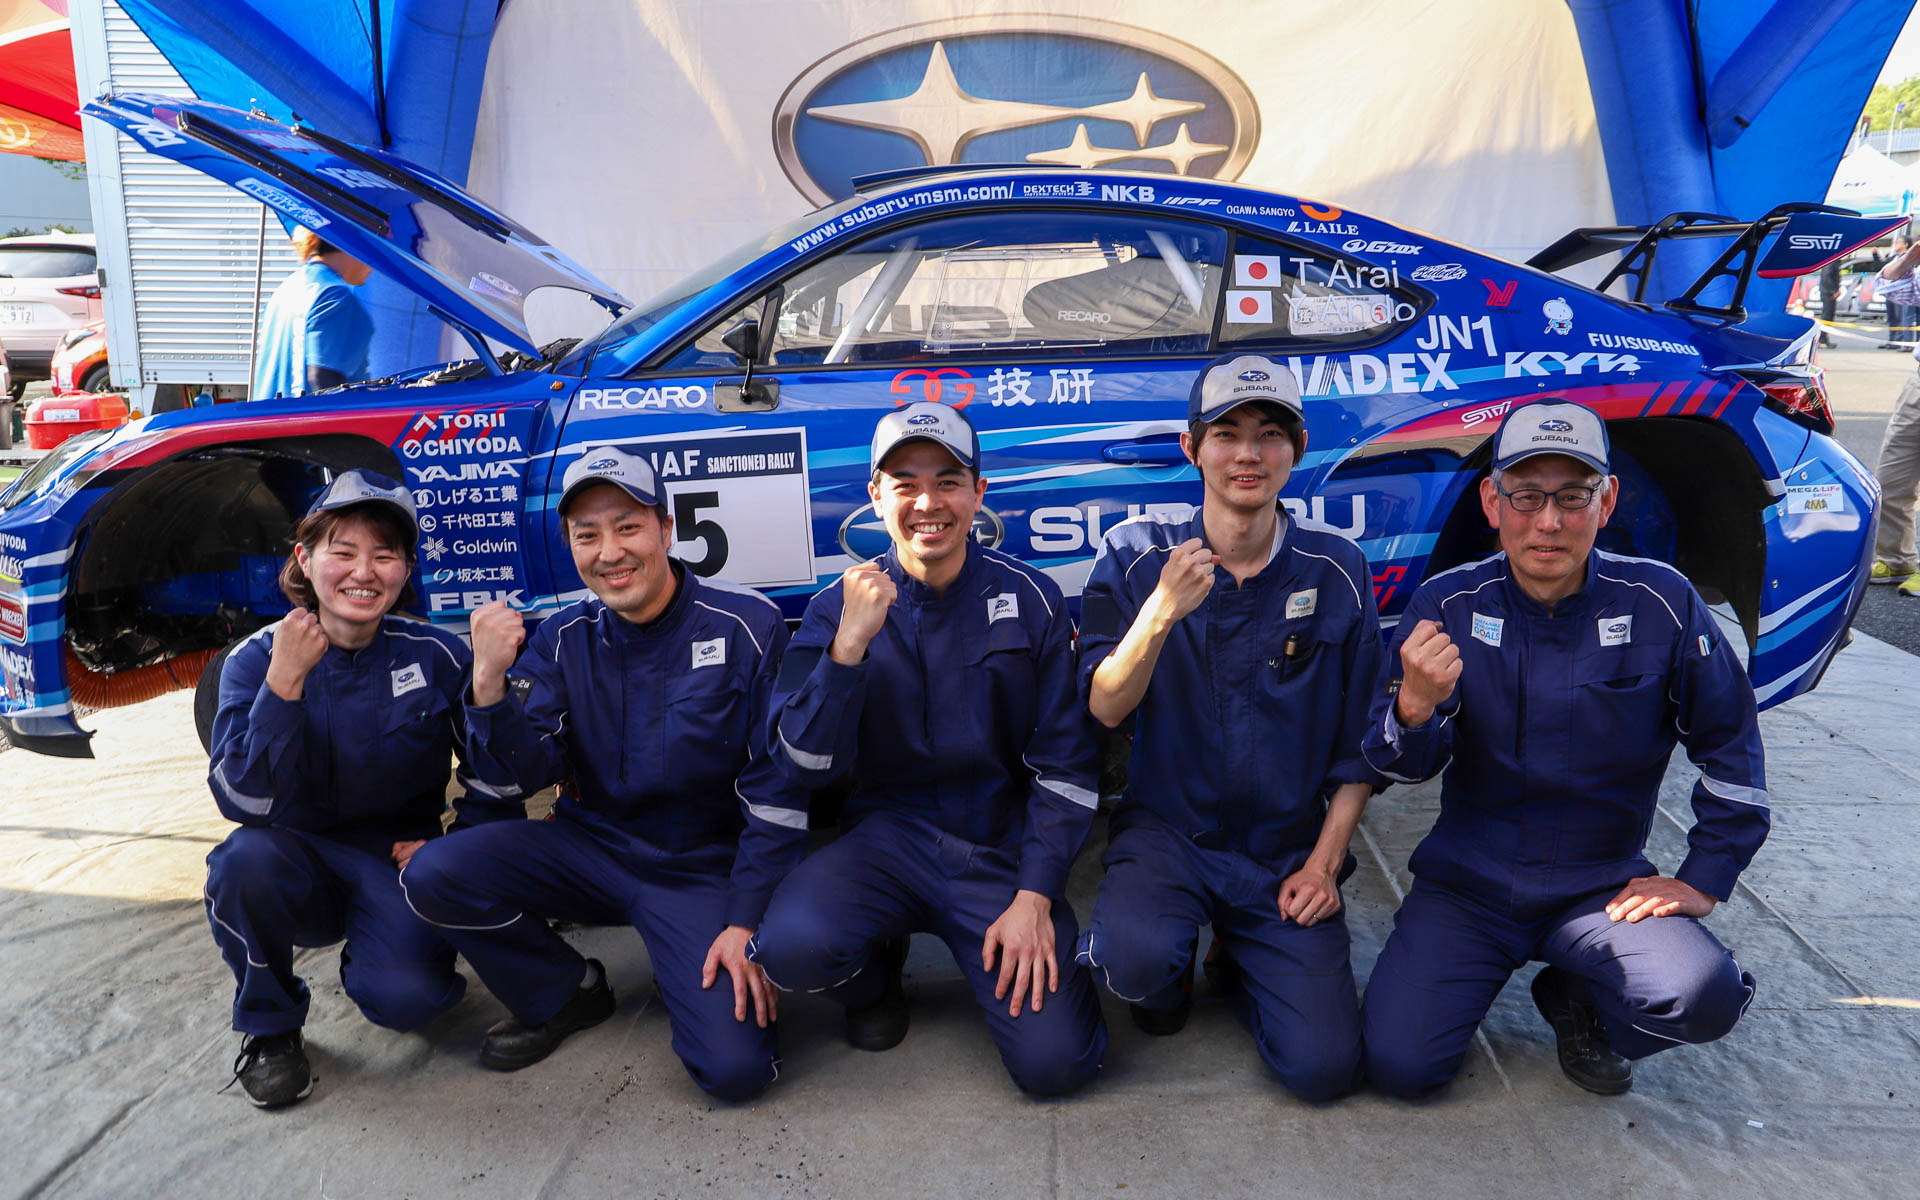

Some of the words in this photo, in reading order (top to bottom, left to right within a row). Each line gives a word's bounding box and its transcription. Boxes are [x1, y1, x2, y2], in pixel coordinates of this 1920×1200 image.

[1024, 185, 1074, 193] DEXTECH
[1101, 184, 1155, 203] NKB
[791, 181, 1014, 254] www.subaru-msm.com/
[1226, 205, 1258, 215] OGAWA
[1259, 206, 1295, 217] SANGYO
[1303, 221, 1359, 236] LAILE
[1290, 257, 1400, 289] T.Arai
[1057, 310, 1112, 324] RECARO
[1283, 293, 1416, 325] Y.Ando
[1416, 315, 1498, 357] JN1
[1588, 333, 1700, 356] FUJISUBARU
[579, 385, 707, 410] RECARO
[988, 367, 1096, 408] 技研
[1233, 385, 1277, 393] SUBARU
[438, 412, 506, 429] TORII
[423, 436, 522, 456] CHIYODA
[1531, 434, 1579, 445] SUBARU
[407, 461, 521, 483] YAJIMA
[707, 454, 766, 474] SANCTIONED
[767, 451, 796, 470] RALLY
[437, 485, 519, 505] しげる工業
[442, 511, 516, 530] 千代田工業
[673, 490, 729, 579] 5
[453, 538, 517, 555] Goldwin
[457, 566, 515, 583] 坂本工業
[430, 589, 526, 612] FBK
[1473, 626, 1501, 642] GOALS
